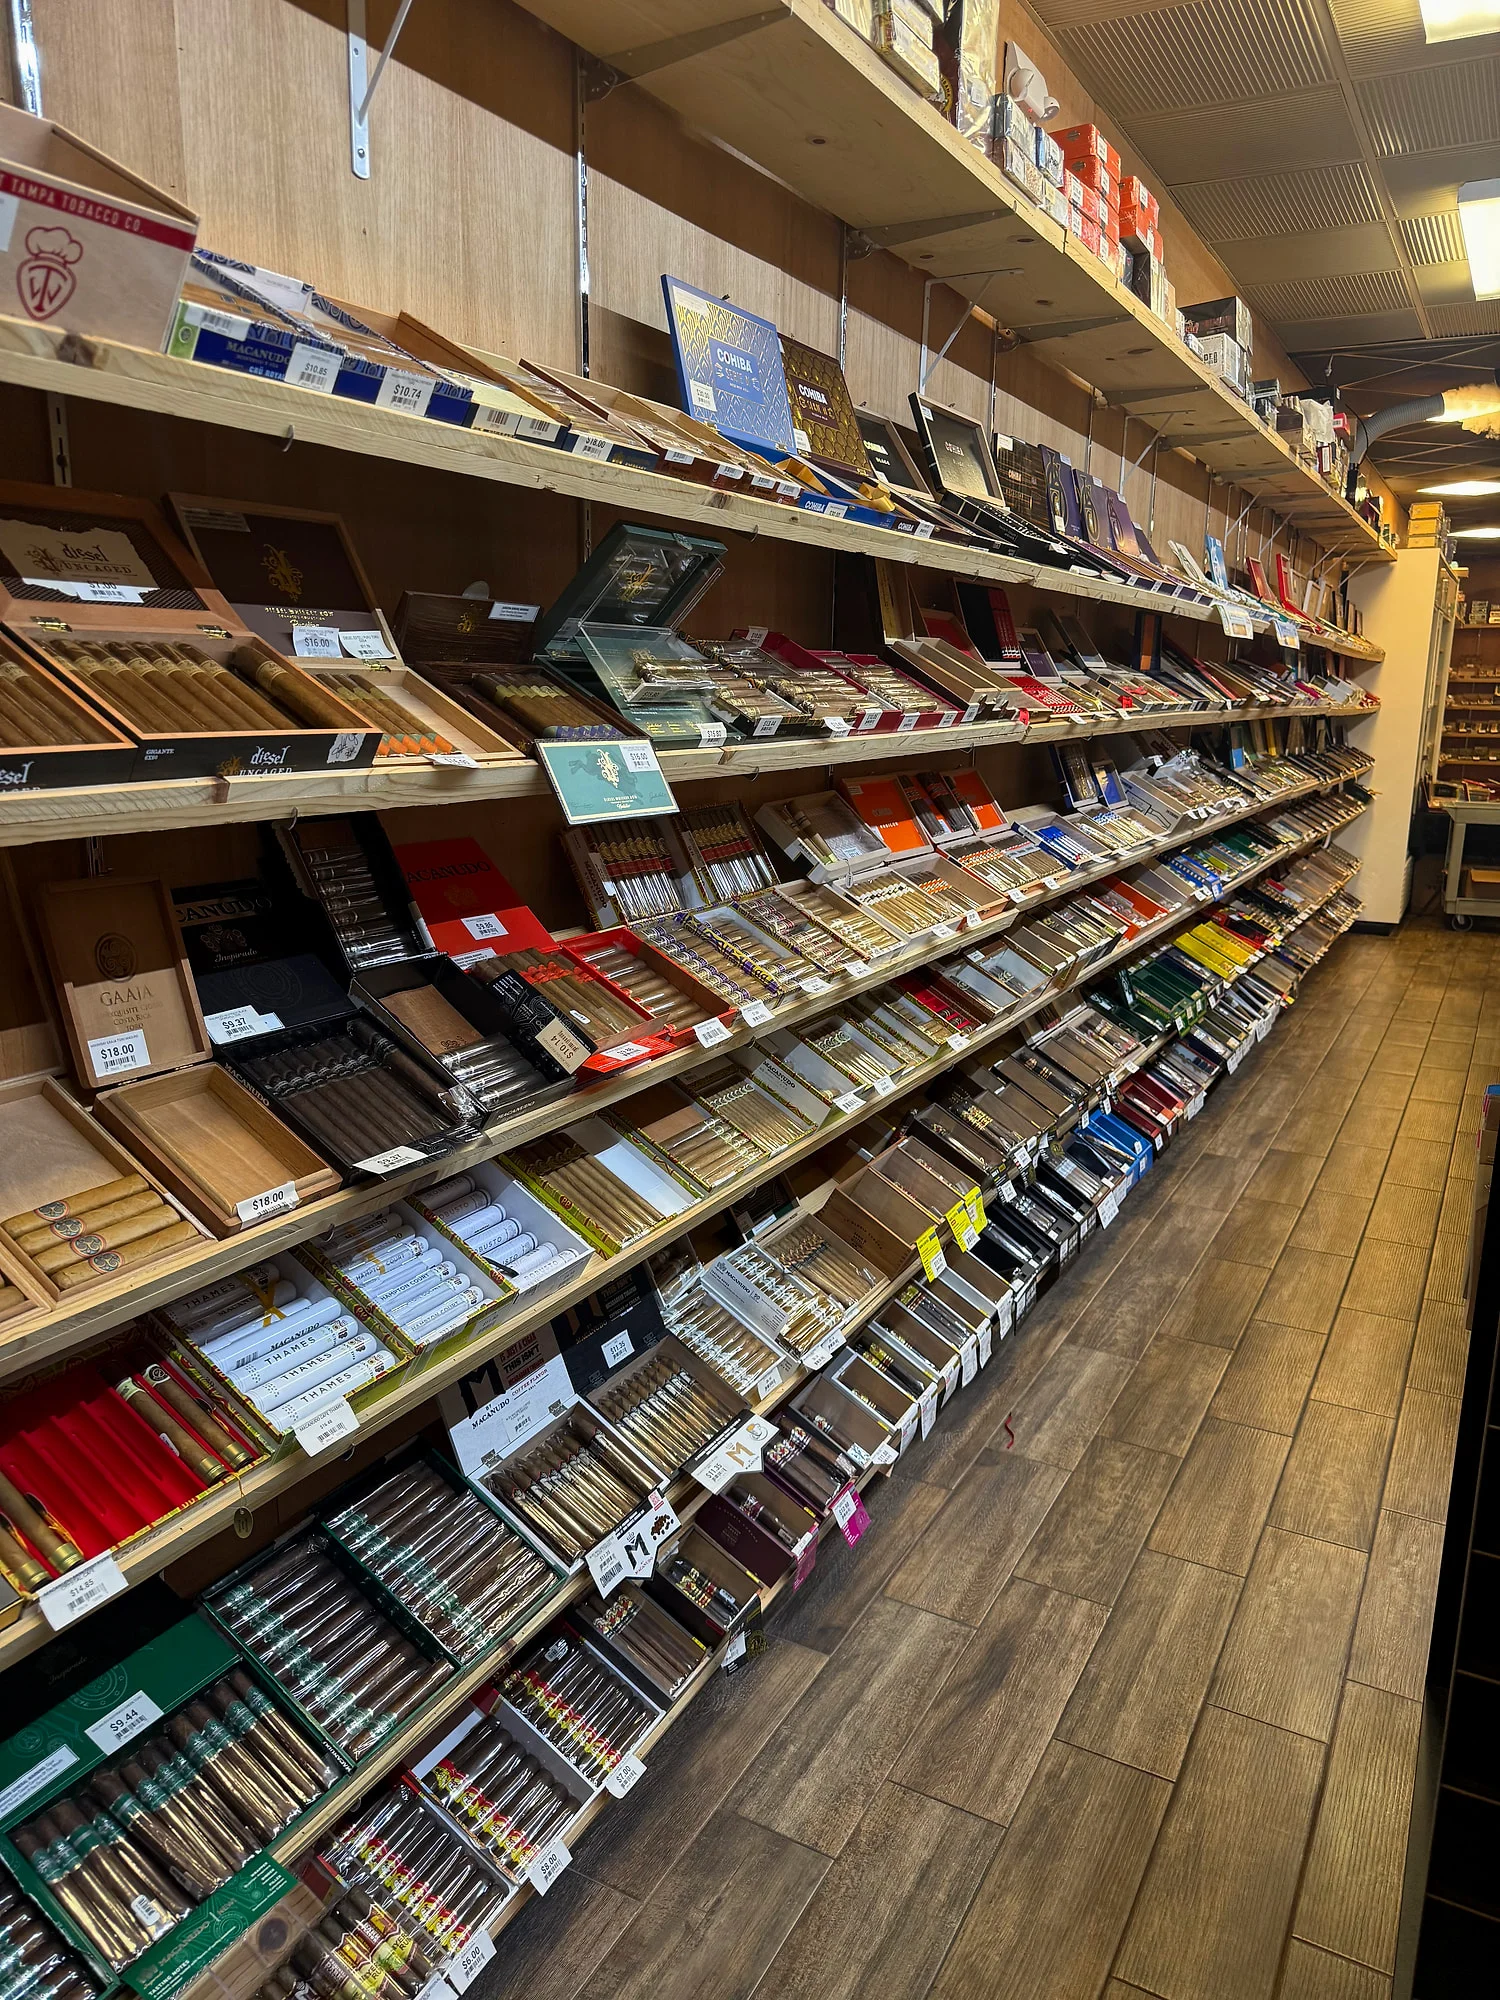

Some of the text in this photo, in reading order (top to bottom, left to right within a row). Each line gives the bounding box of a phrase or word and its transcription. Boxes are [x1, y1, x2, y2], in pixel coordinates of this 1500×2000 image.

[12, 179, 55, 203] TAMPA
[61, 195, 119, 225] TOBACCO
[125, 219, 144, 234] CO.
[717, 348, 753, 374] COHIBA
[394, 383, 422, 400] $10.74
[798, 384, 828, 405] COHIBA
[804, 500, 826, 514] COHIBA
[57, 540, 110, 562] diesel
[64, 562, 133, 574] UNCAGED
[304, 637, 330, 648] $16.00
[249, 745, 292, 766] diesel
[222, 1017, 247, 1030] $9.37
[101, 1043, 135, 1060] $18.00
[550, 1034, 574, 1060] $10.14
[224, 1062, 271, 1108] MACANUDO
[763, 1060, 796, 1089] MACANUDO
[252, 1190, 285, 1211] $18.00
[355, 1265, 381, 1281] HAMPTO
[523, 1260, 559, 1281] ROBUSTO
[184, 1282, 236, 1310] THAMES
[381, 1272, 430, 1301] HAMPTON COURT
[270, 1322, 320, 1352] MACANUDO
[264, 1335, 317, 1366] THAMES
[504, 1360, 521, 1374] THIS
[522, 1344, 541, 1362] ISN'T
[281, 1351, 333, 1382] THAMES
[530, 1368, 549, 1383] FLAVOR
[300, 1371, 353, 1404] THAMES
[471, 1397, 511, 1431] MACANUDO
[705, 1462, 723, 1480] $11.35
[624, 1532, 651, 1571] M
[70, 1578, 95, 1598] $14.85
[110, 1708, 139, 1733] $9.44
[322, 1741, 352, 1773] MACANUDO
[616, 1765, 632, 1784] $7.00
[540, 1853, 558, 1875] $8.00
[158, 1920, 211, 1967] MACANUDO
[461, 1945, 482, 1971] $6.00
[148, 1959, 191, 1997] TASTING NOTES
